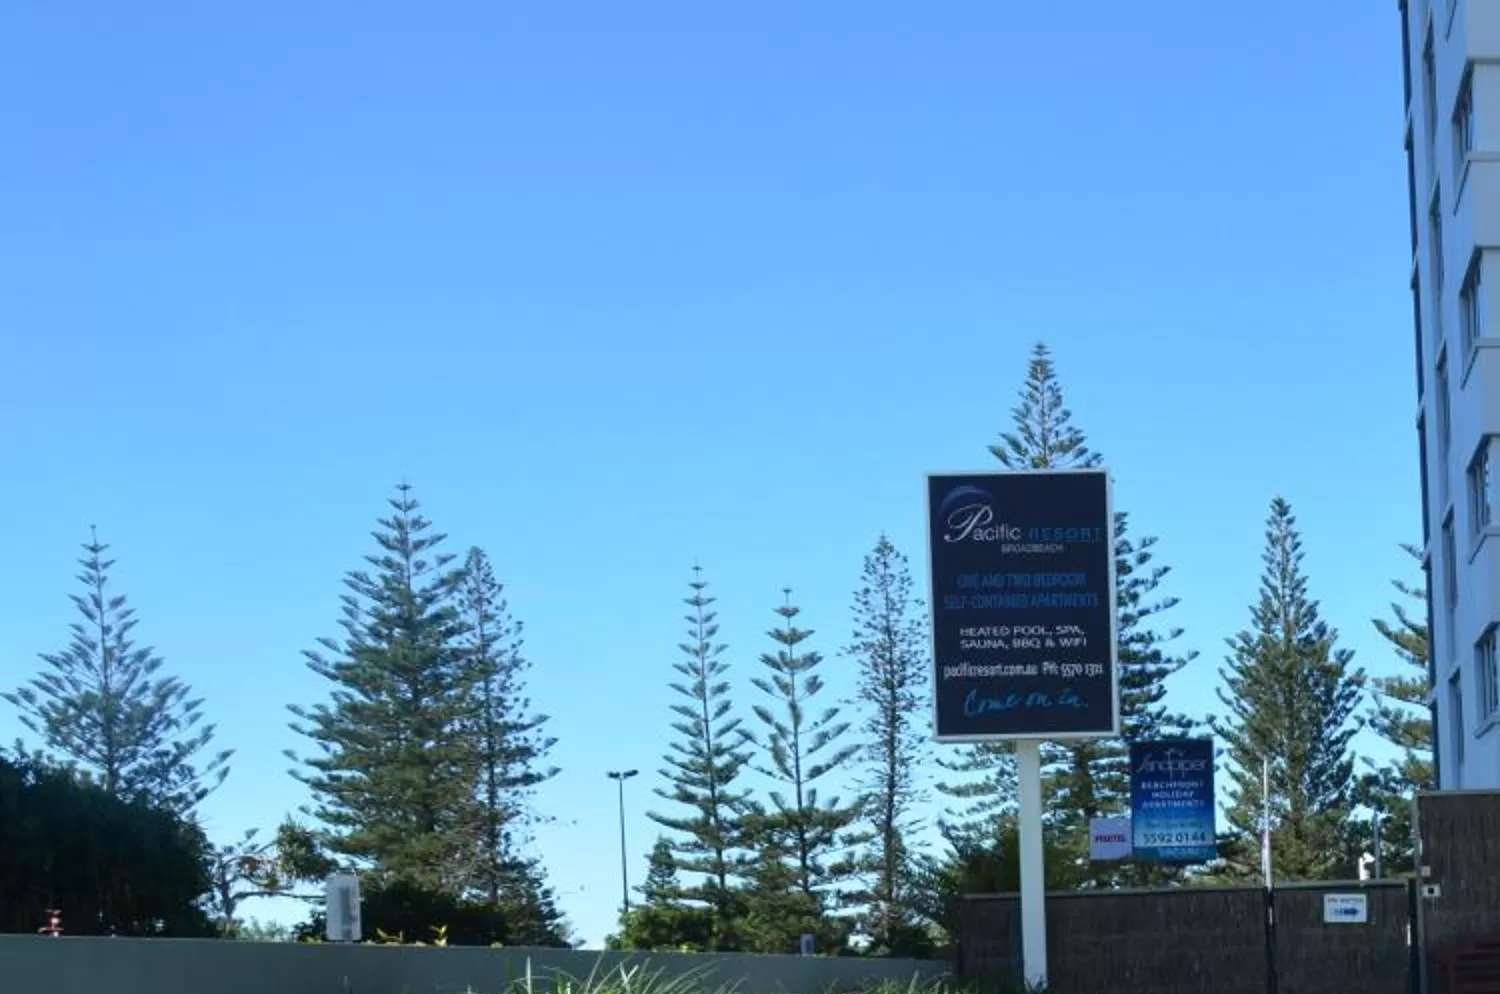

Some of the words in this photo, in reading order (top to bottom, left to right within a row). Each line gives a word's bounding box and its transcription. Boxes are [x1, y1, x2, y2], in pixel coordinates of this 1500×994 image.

[943, 502, 1021, 542] Pacific
[1028, 527, 1102, 542] RESORT
[959, 626, 1010, 637] HEATED
[1013, 625, 1052, 637] POOL,
[960, 638, 1009, 650] SAUNA,
[1012, 638, 1040, 649] BBQ
[1045, 637, 1056, 648] &
[963, 688, 1018, 718] Come
[1025, 691, 1053, 708] on
[1151, 790, 1194, 799] HOLIDAY
[1143, 831, 1173, 846] 5592
[1175, 831, 1206, 844] 0144
